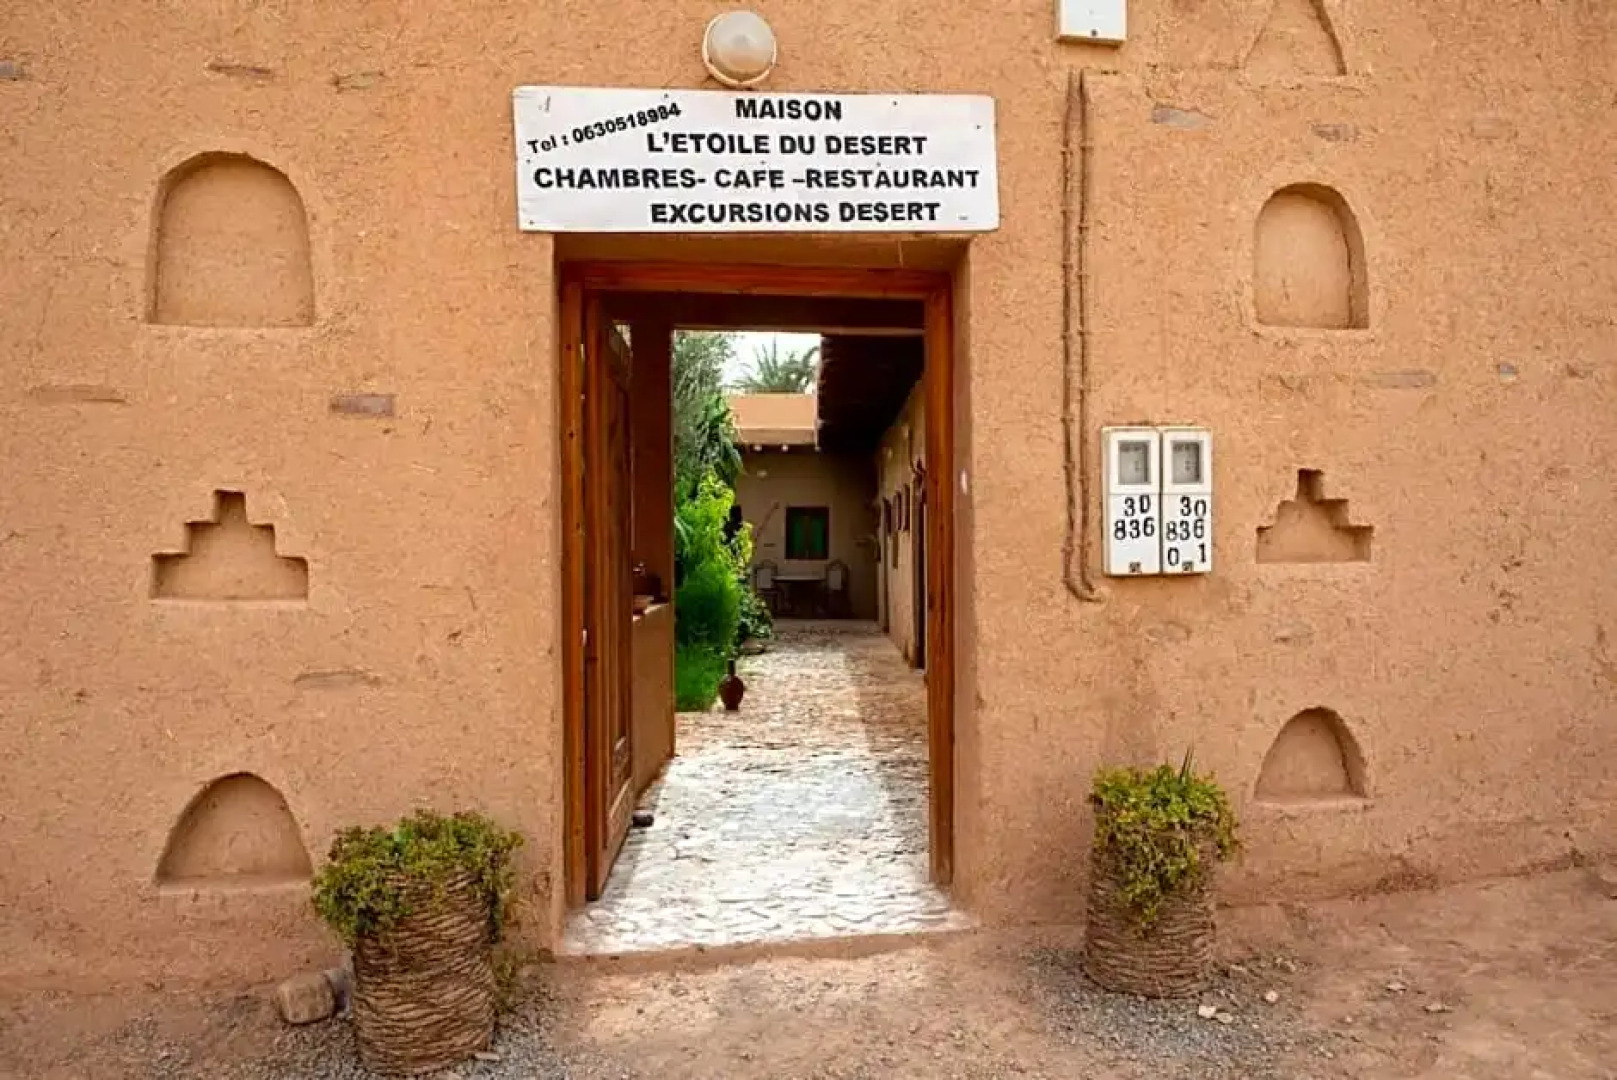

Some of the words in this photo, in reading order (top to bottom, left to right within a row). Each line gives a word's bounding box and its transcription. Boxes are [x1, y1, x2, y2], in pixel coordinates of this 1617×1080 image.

[736, 98, 842, 121] MAISON
[647, 132, 769, 154] L'ETOILE
[779, 135, 815, 155] DU
[825, 135, 928, 156] DESERT
[714, 168, 785, 189] CAFE
[651, 203, 830, 223] EXCURSIONS
[839, 202, 941, 223] DESERT
[1124, 494, 1151, 517] 30
[1180, 496, 1207, 517] 30
[1114, 516, 1155, 541] 836
[1166, 518, 1205, 541] 836
